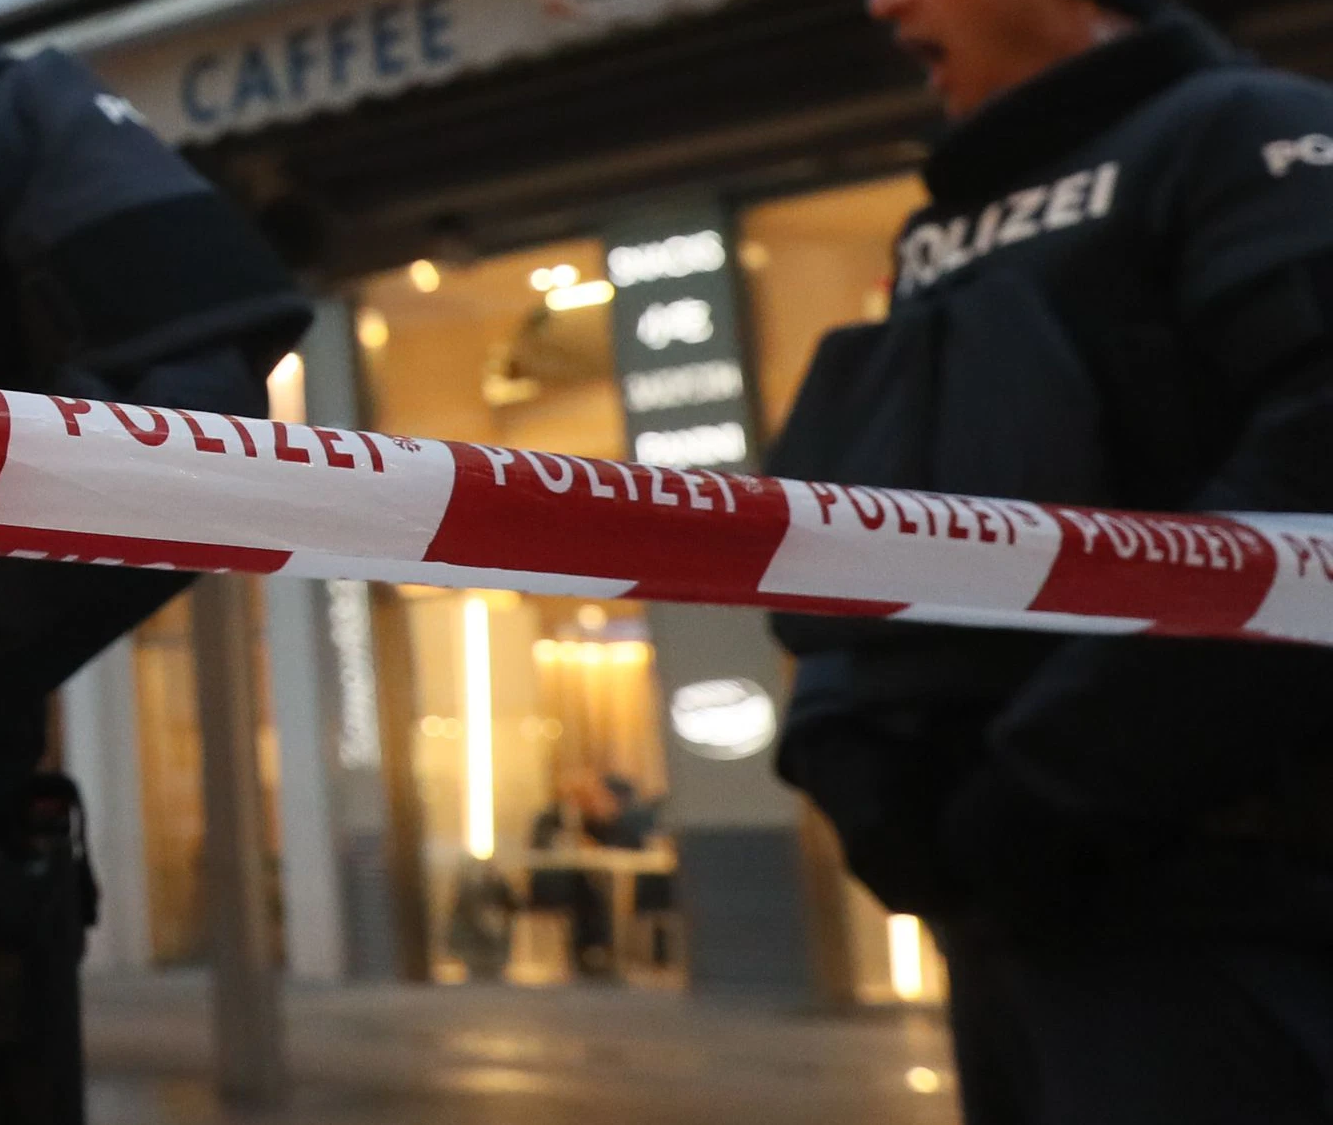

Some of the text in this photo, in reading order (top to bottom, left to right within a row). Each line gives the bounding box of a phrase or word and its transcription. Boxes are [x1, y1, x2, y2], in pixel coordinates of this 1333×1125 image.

[48, 395, 384, 474] POLIZEI
[470, 443, 737, 513] POLIZEI
[806, 481, 1017, 545] POLIZEI
[1058, 508, 1243, 571] POLIZEI
